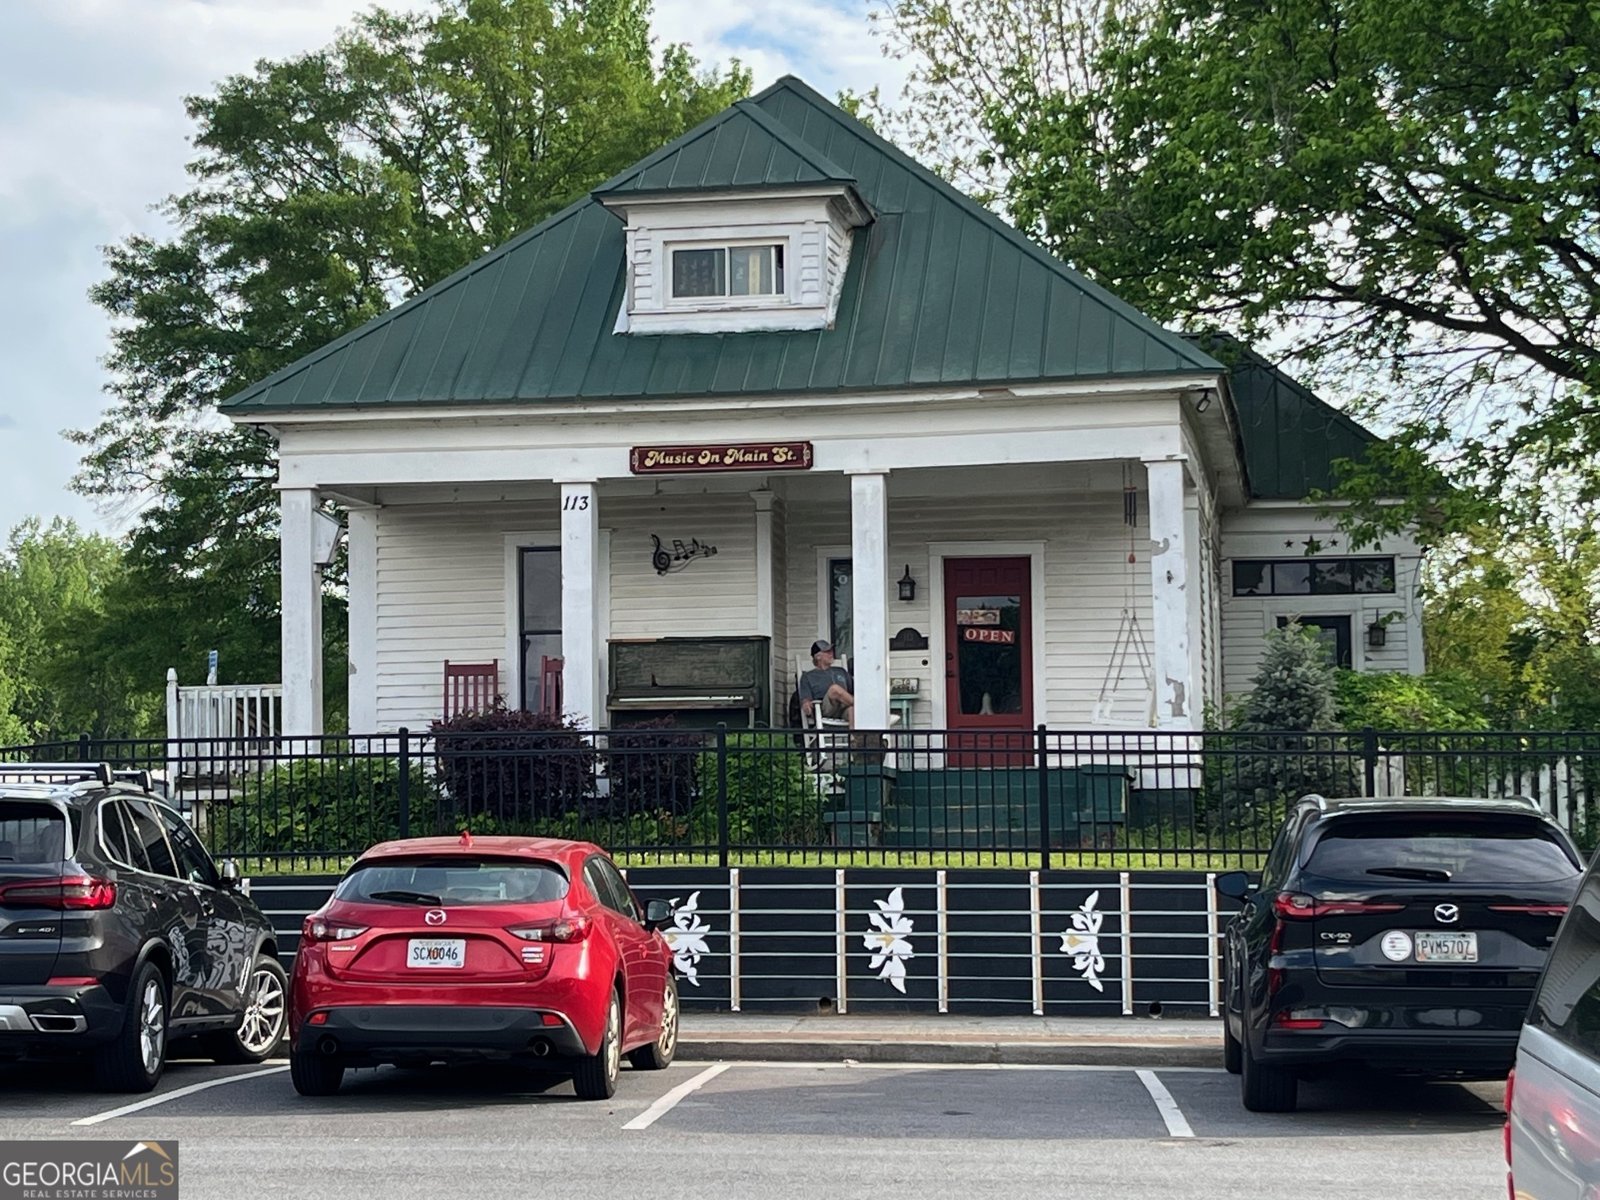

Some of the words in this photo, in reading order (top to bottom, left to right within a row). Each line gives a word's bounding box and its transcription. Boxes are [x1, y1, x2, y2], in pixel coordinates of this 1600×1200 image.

[644, 451, 695, 467] Music
[698, 450, 720, 465] On
[723, 448, 768, 464] Main
[771, 447, 797, 463] St.
[563, 495, 589, 511] 113
[965, 628, 1014, 642] OPEN
